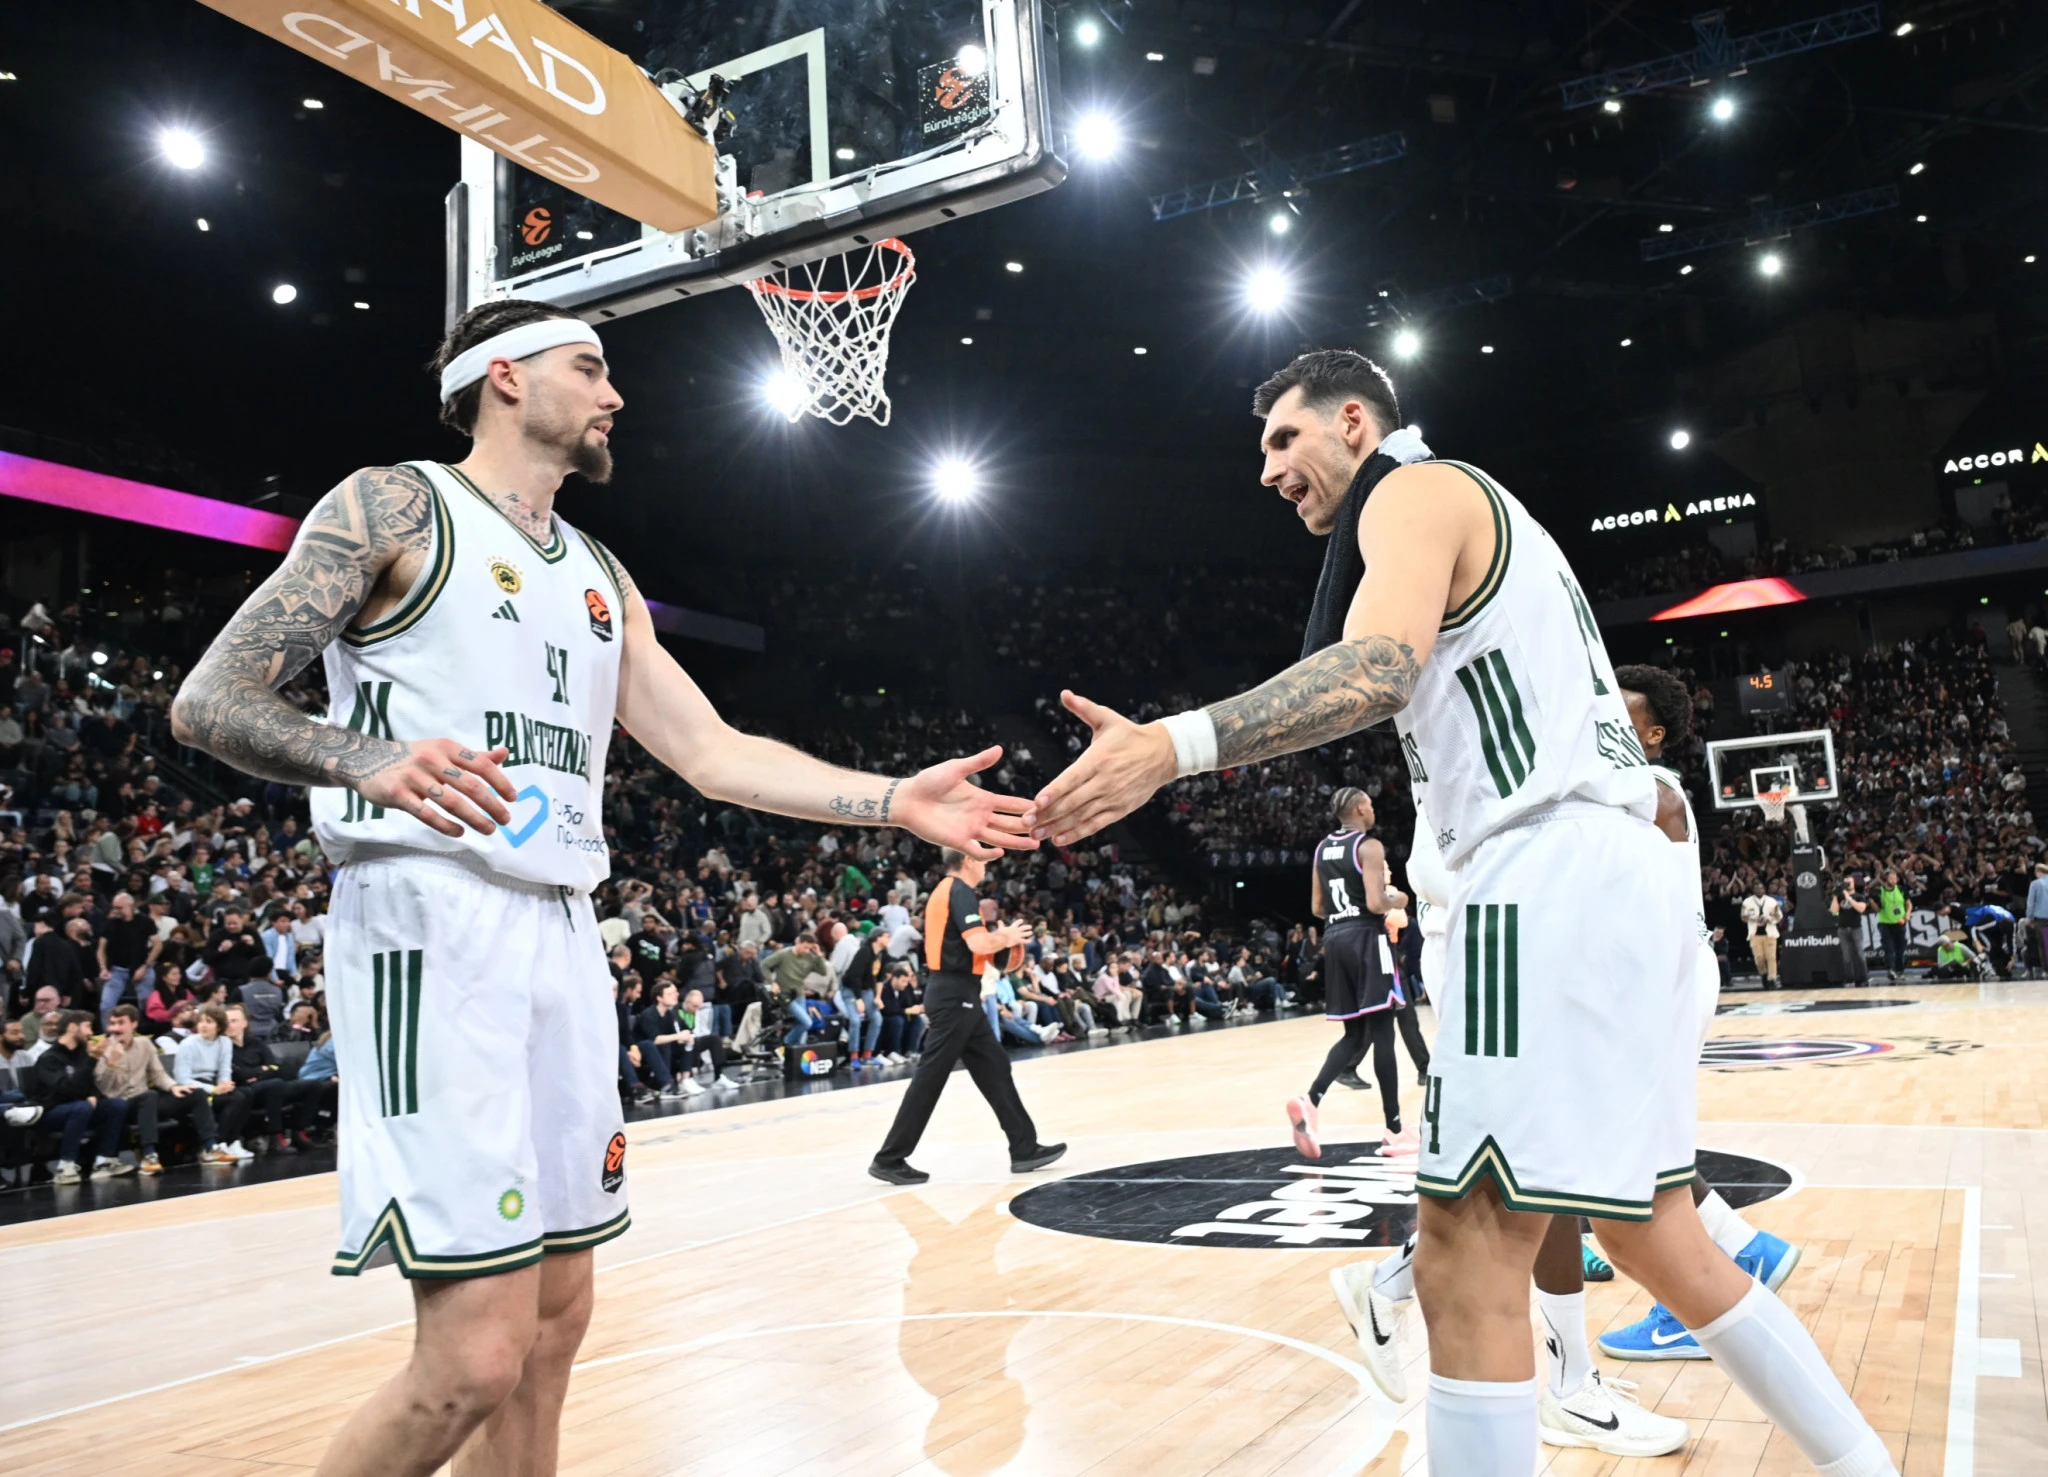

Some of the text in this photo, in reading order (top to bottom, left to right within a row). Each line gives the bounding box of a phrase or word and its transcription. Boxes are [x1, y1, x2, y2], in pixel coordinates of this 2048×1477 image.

[390, 0, 607, 115] HAD
[281, 12, 600, 184] ETIHAD
[923, 106, 989, 134] EuroLeague
[511, 243, 563, 267] EuroLeague
[1943, 448, 2024, 474] ACCOR
[1591, 492, 1756, 532] ACCOR ARENA
[544, 640, 570, 706] 41
[1749, 673, 1773, 689] 4.5
[1784, 934, 1841, 948] nutribulle
